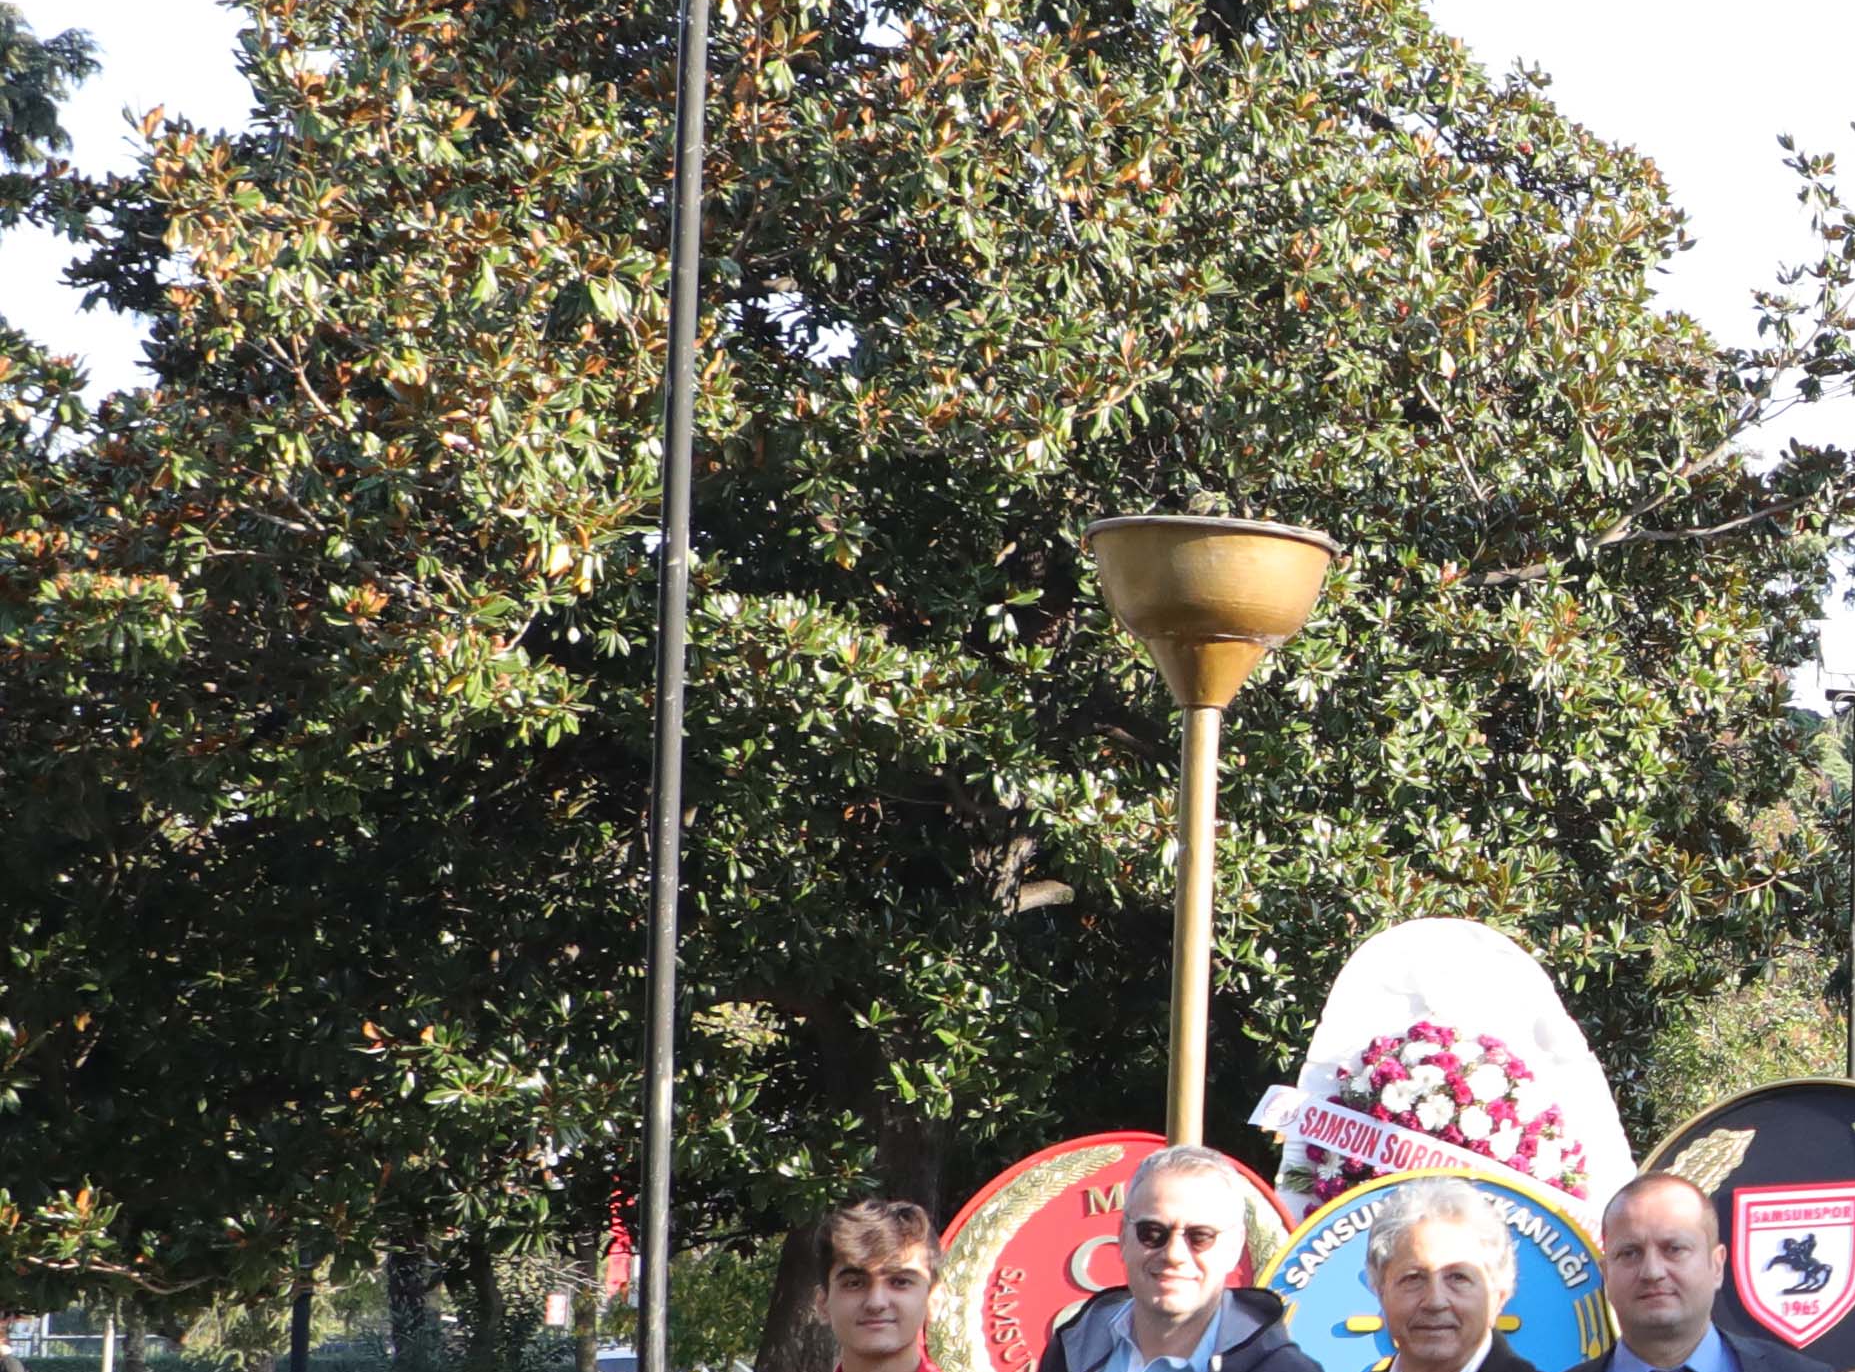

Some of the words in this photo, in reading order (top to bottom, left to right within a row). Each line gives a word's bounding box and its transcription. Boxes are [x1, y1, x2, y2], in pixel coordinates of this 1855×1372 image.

[1299, 1106, 1383, 1159] SAMSUN
[1752, 1206, 1852, 1223] SAMSUNSPOR
[1782, 1300, 1820, 1316] 1965
